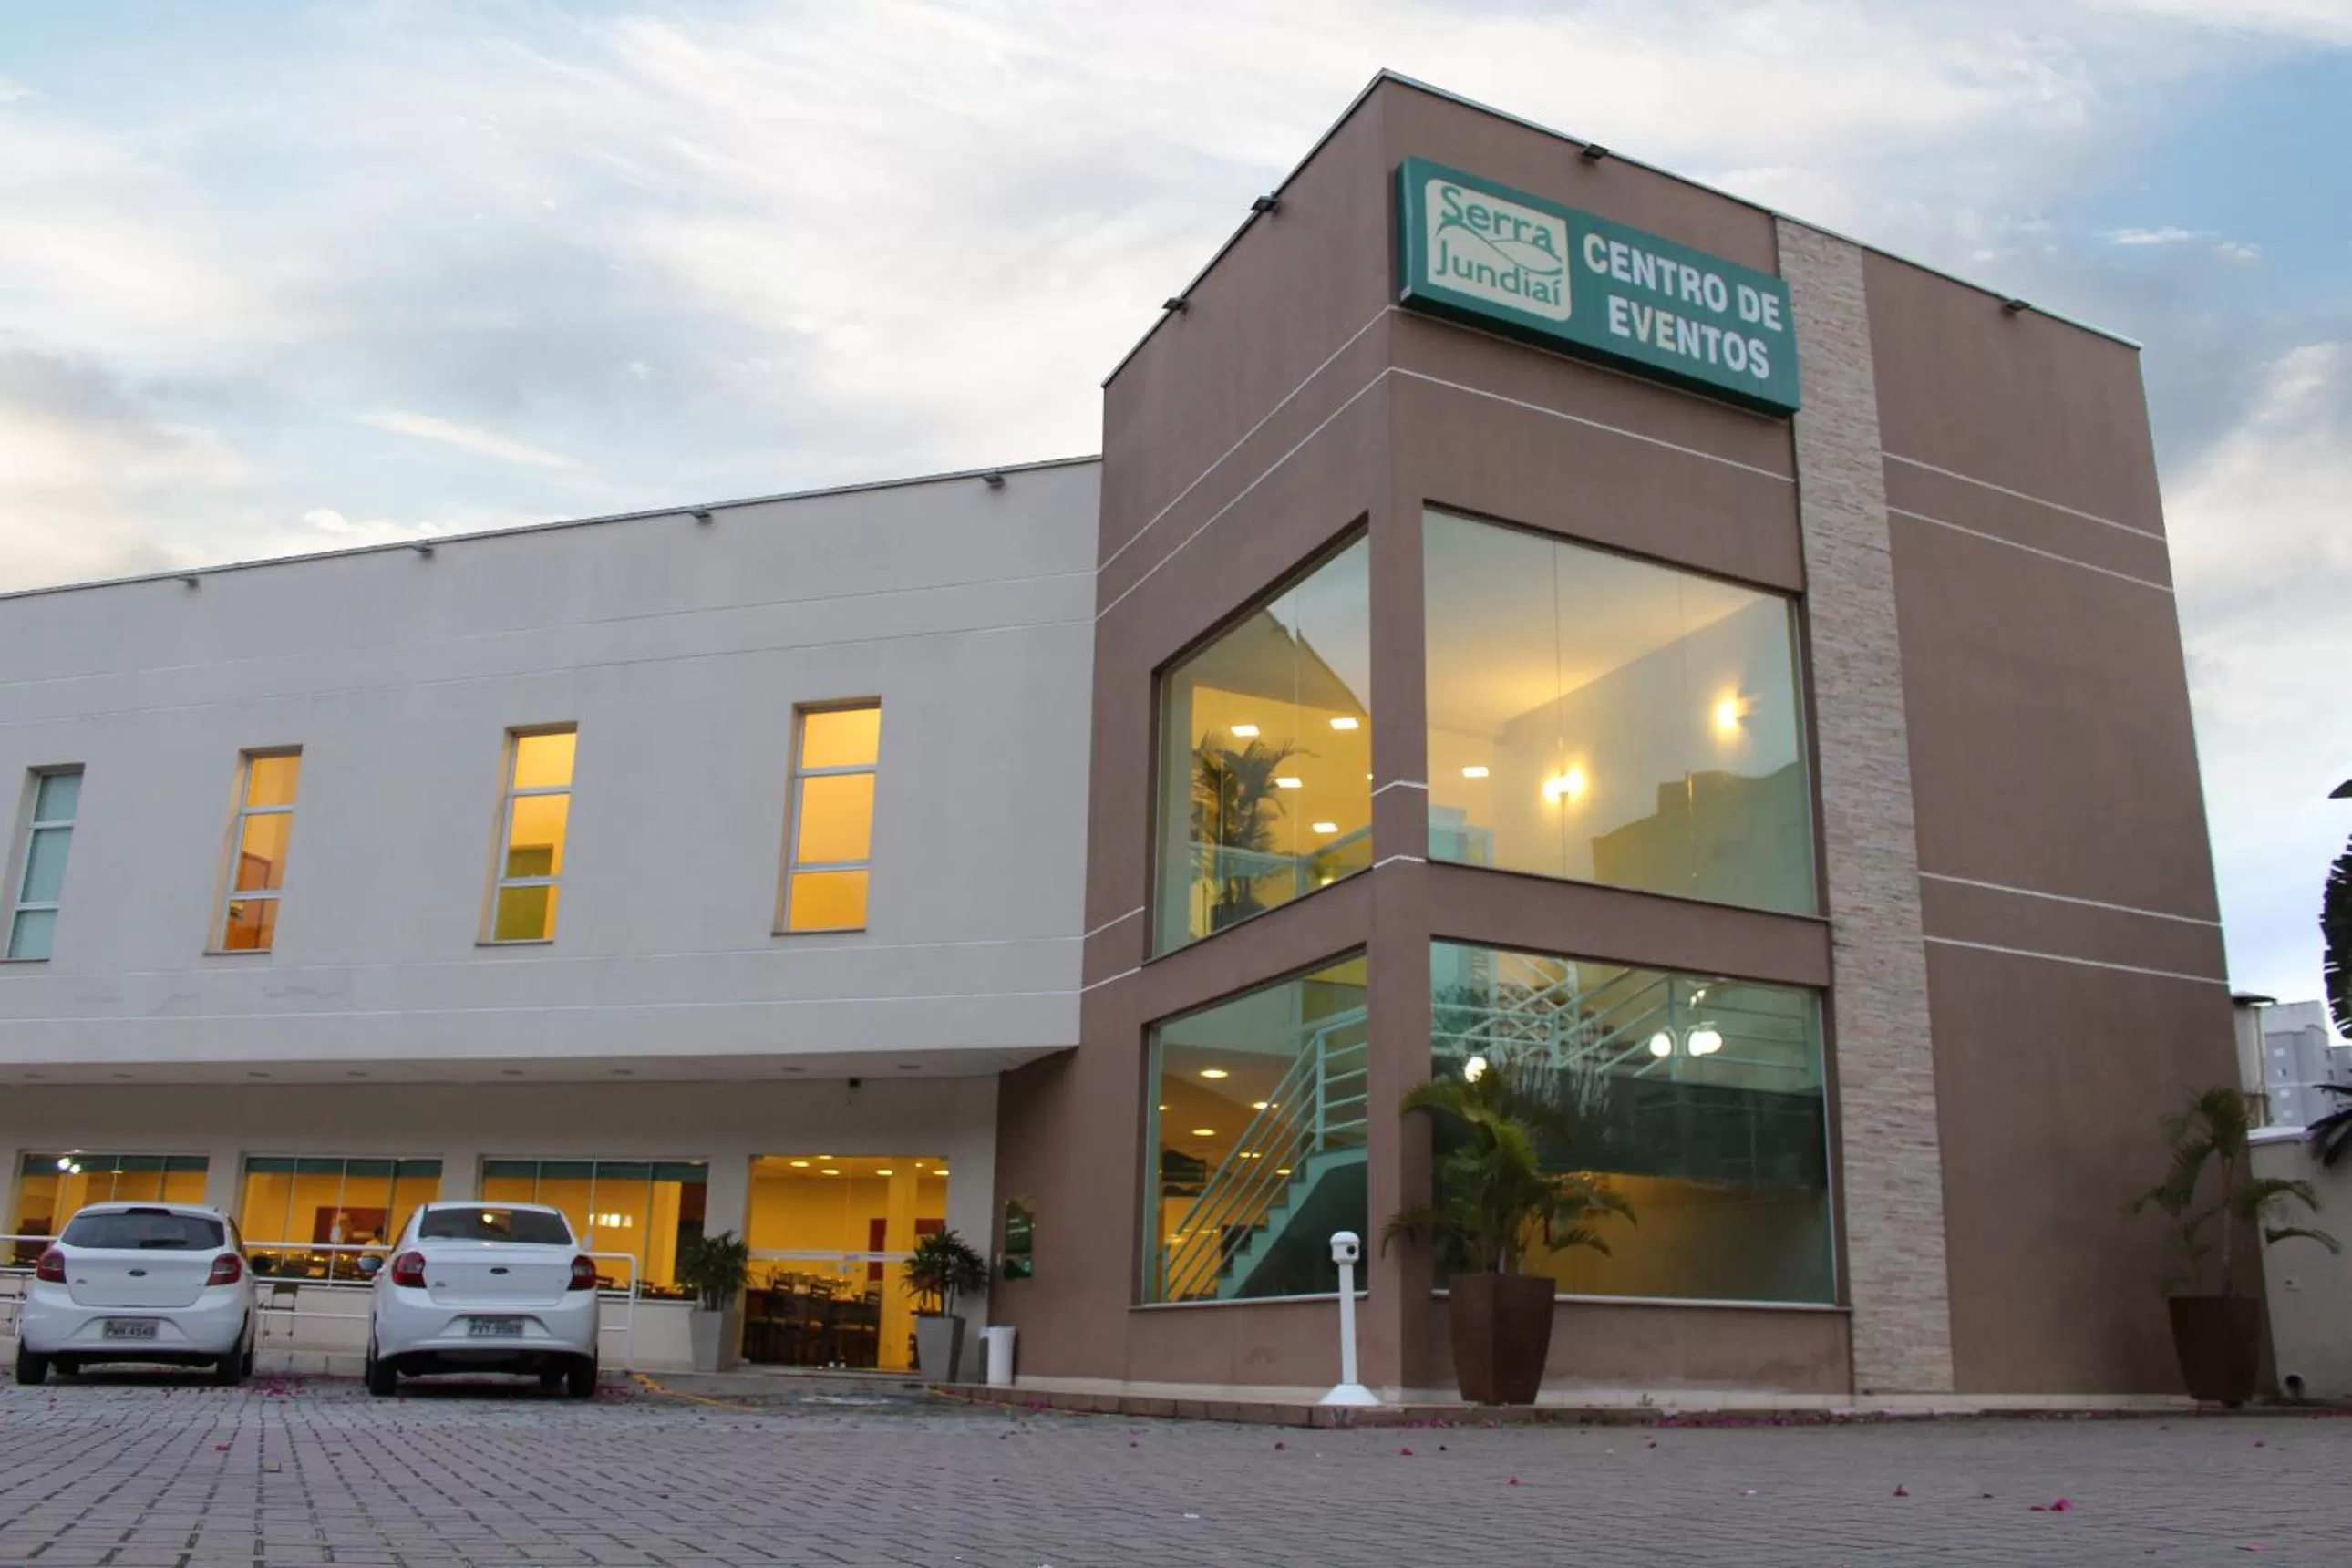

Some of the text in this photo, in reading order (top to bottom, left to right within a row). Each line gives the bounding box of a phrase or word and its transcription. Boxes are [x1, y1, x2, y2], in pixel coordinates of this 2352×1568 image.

[1439, 184, 1556, 255] Serra
[1435, 239, 1563, 307] Jundiaí
[1583, 232, 1783, 333] CENTRO DE
[1607, 294, 1770, 379] EVENTOS
